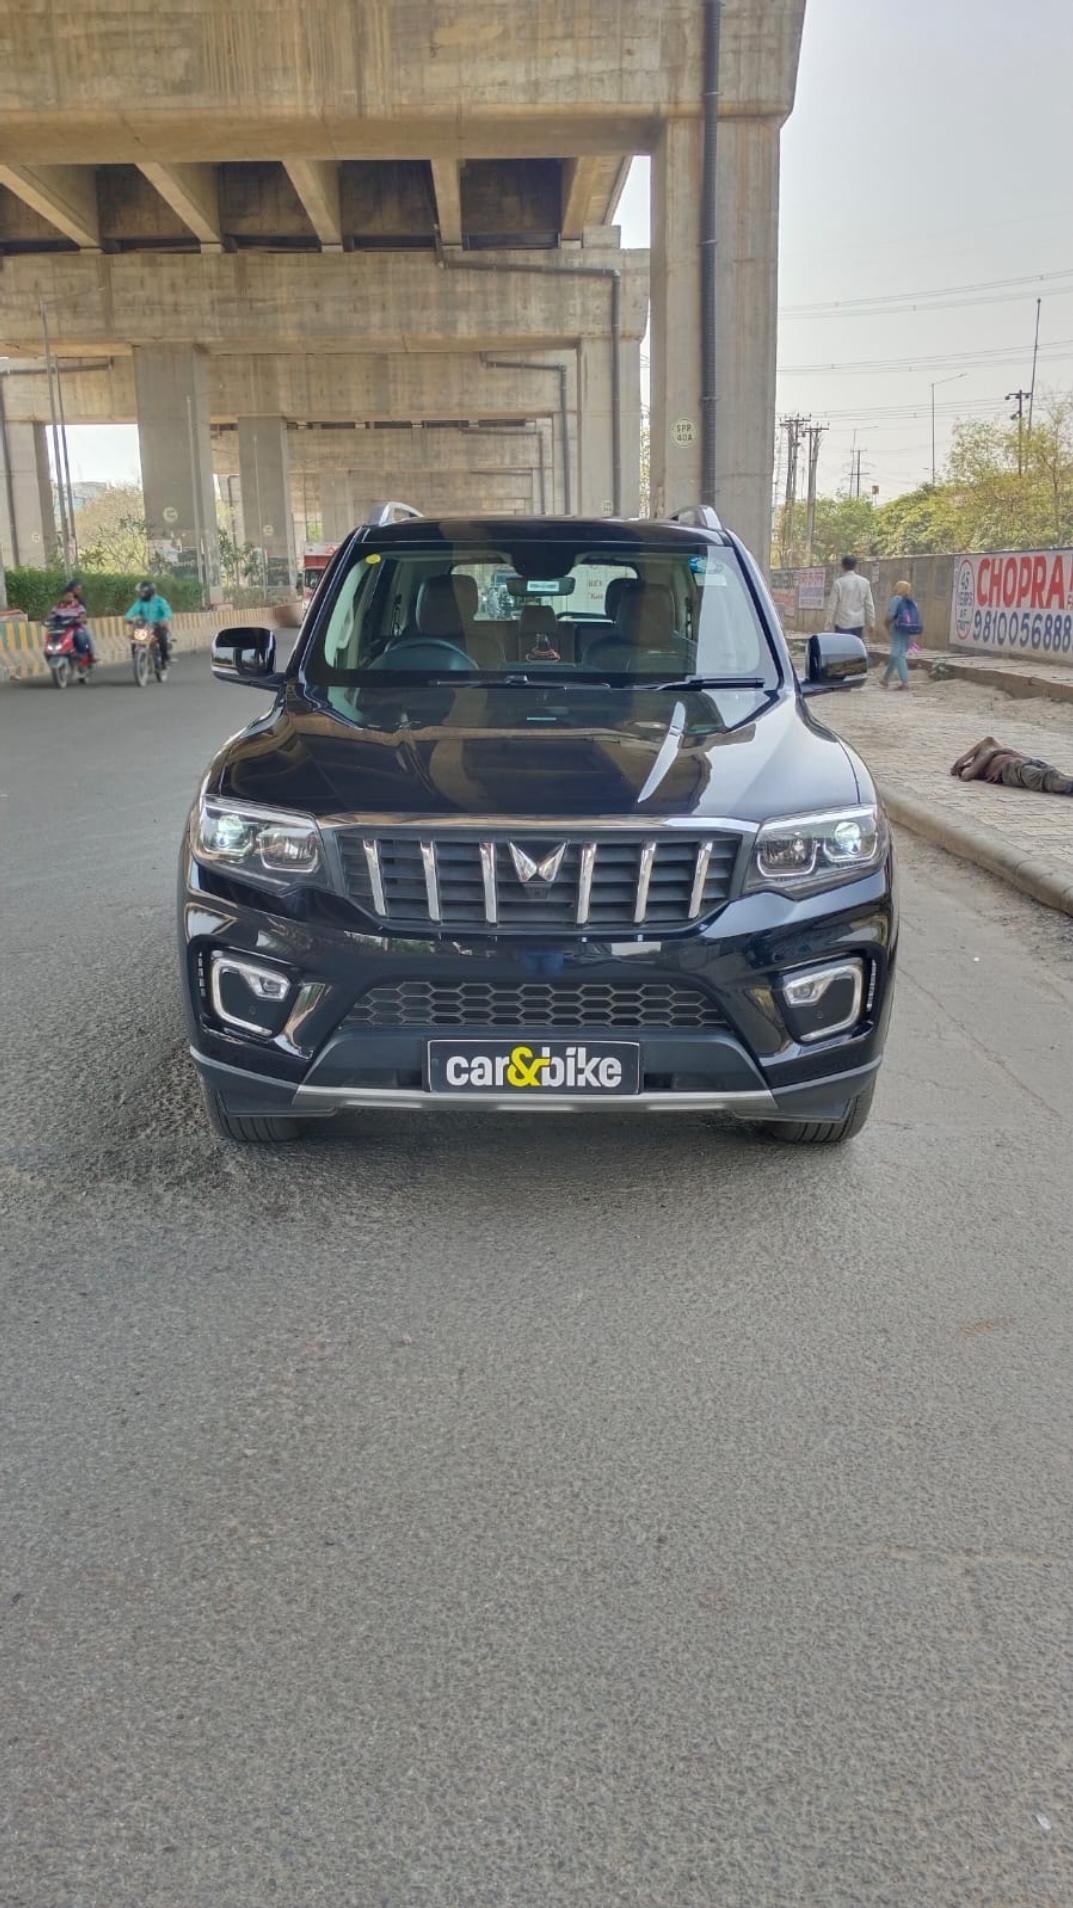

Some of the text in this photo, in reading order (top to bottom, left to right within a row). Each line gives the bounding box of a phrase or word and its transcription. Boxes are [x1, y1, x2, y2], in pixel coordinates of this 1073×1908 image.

[676, 424, 692, 432] SPP
[977, 555, 1065, 609] CHOPRA
[973, 610, 1072, 653] 9810056888
[446, 1046, 622, 1088] car&bike
